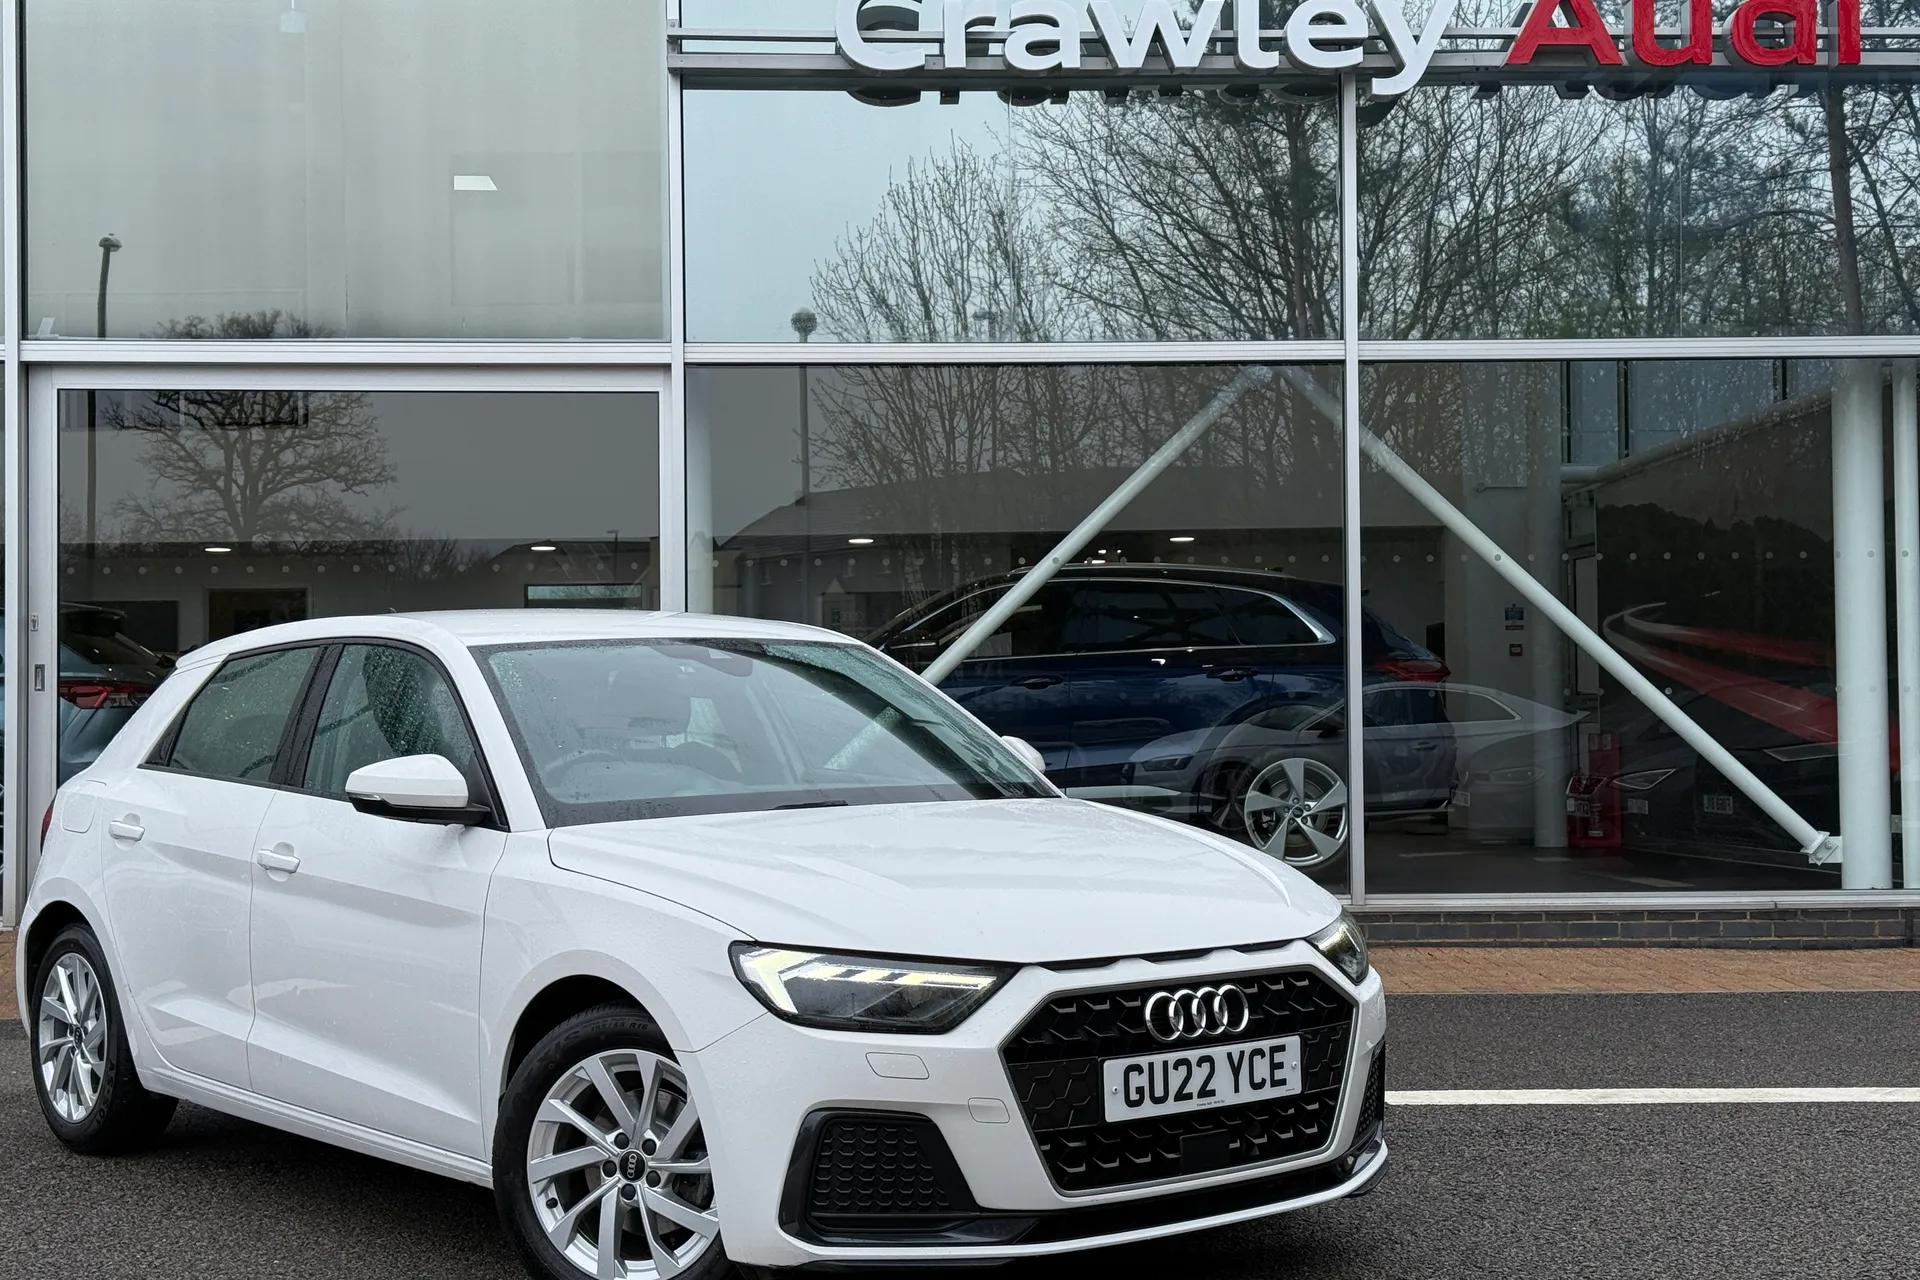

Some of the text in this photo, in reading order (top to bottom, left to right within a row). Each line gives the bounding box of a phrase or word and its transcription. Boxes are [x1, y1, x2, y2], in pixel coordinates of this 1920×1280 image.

[835, 0, 1861, 95] Crawley Audi
[1123, 1044, 1287, 1108] GU22 YCE
